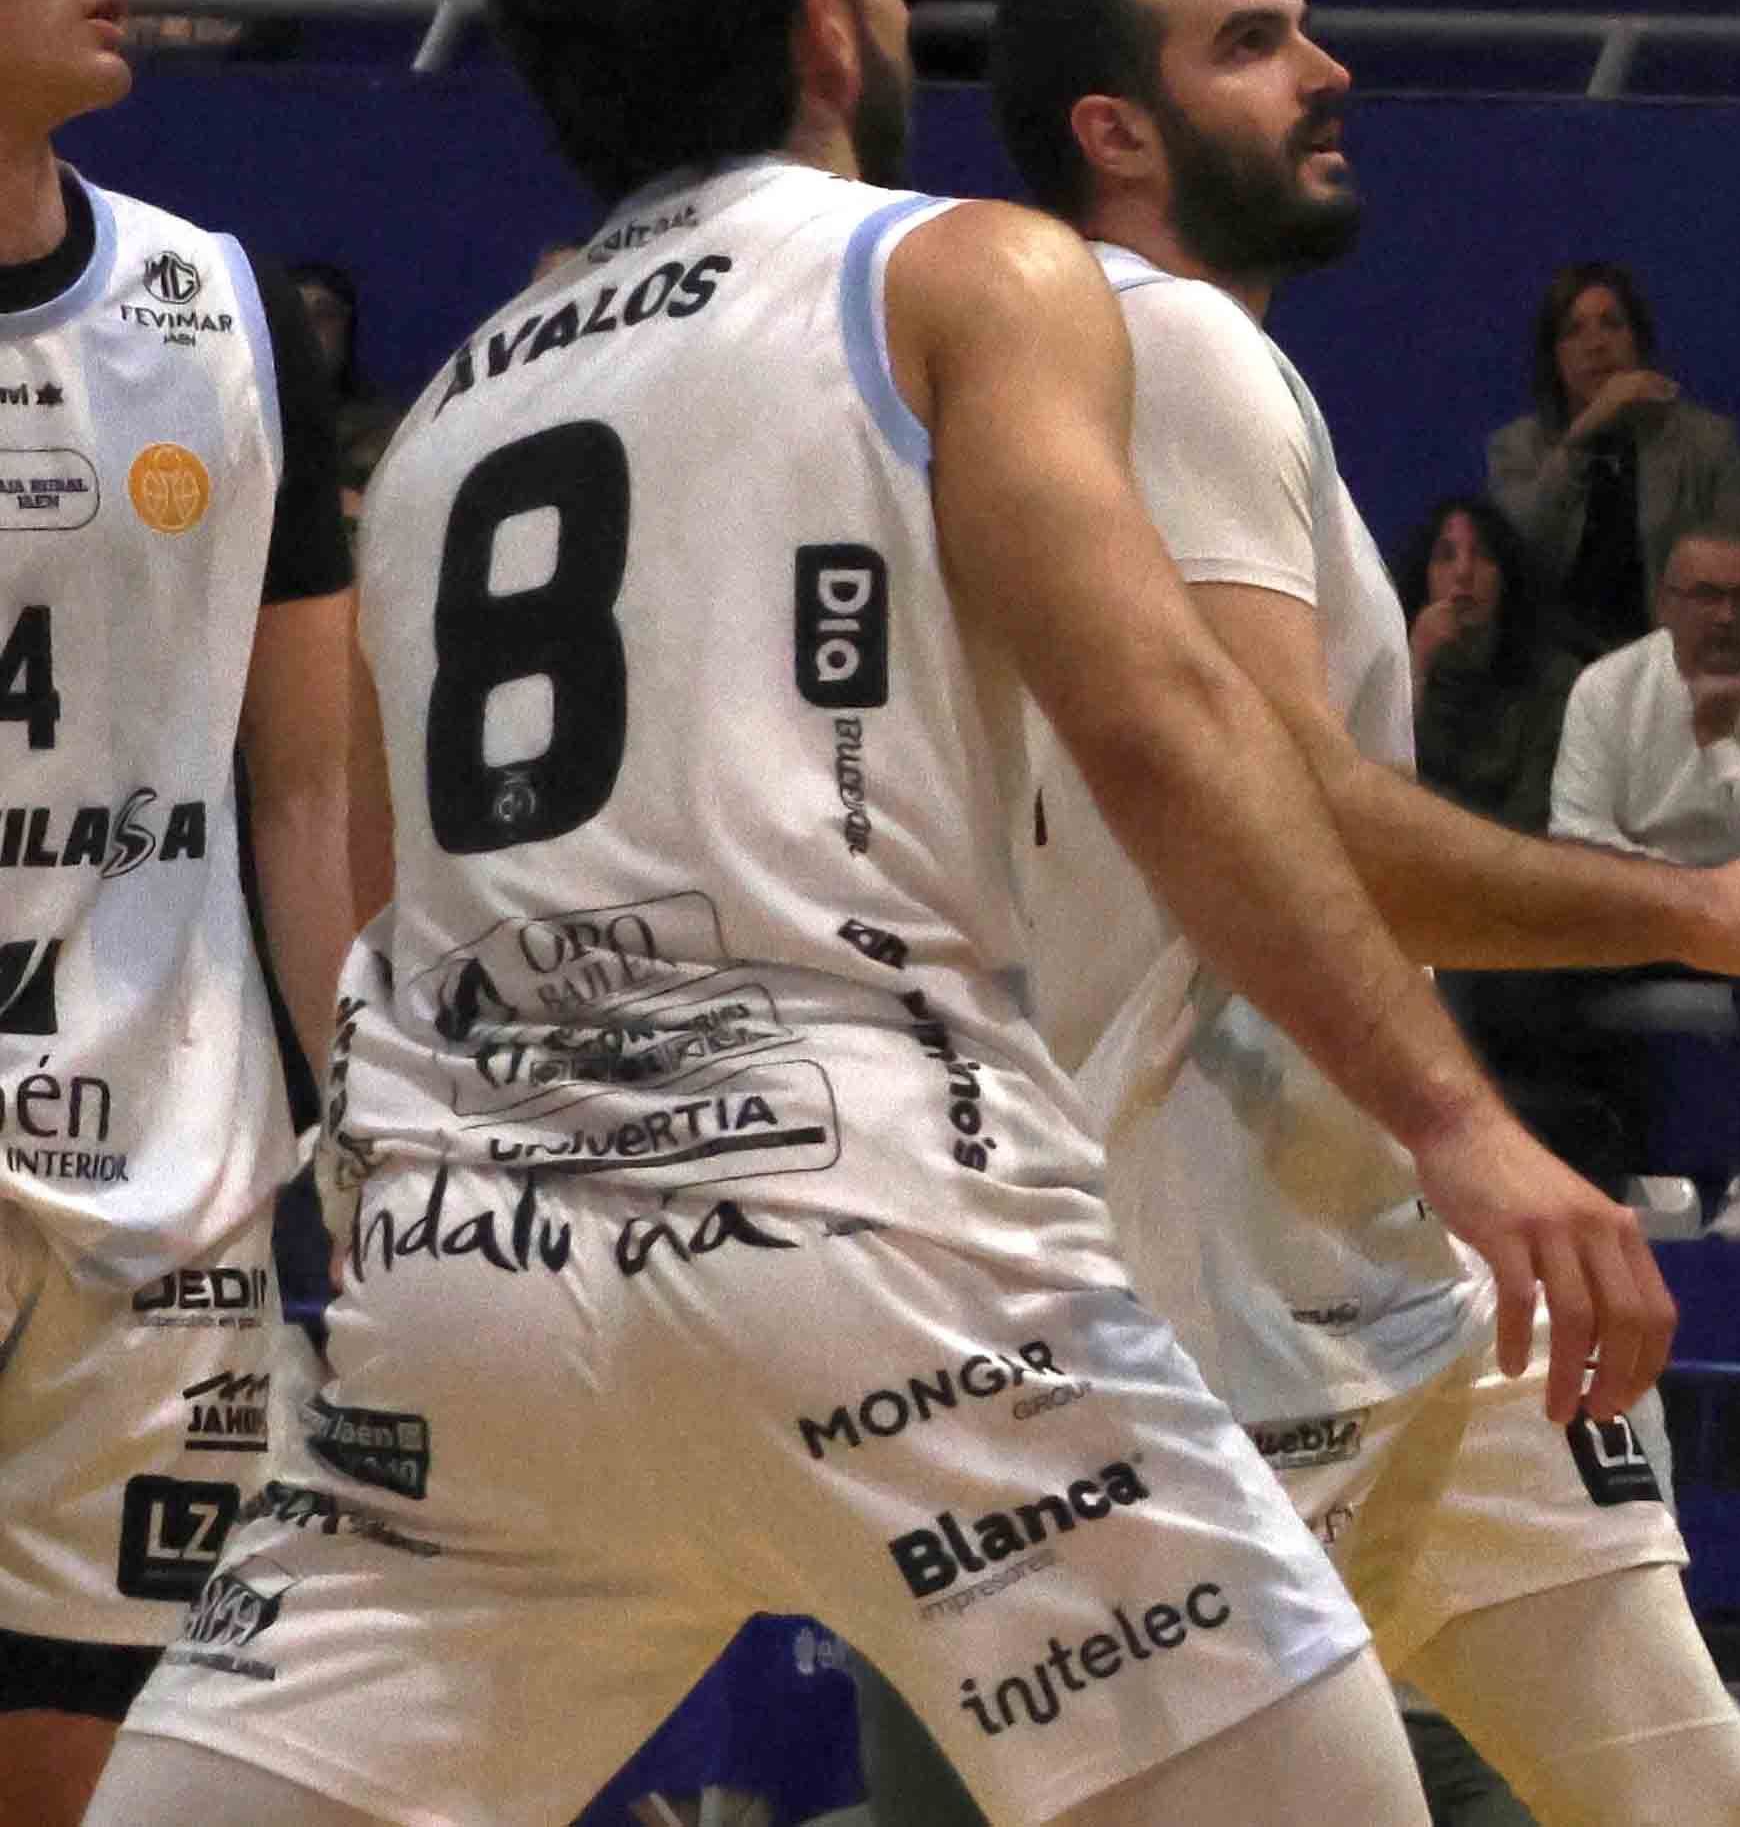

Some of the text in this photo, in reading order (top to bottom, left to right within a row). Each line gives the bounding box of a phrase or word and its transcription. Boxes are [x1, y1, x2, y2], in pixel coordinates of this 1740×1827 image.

[433, 255, 732, 423] AVALOS
[426, 419, 630, 854] 8
[0, 786, 207, 879] ILASA
[0, 1053, 111, 1142] én
[7, 1146, 129, 1182] INTERIOR
[146, 1502, 221, 1561] LZ
[888, 1461, 1150, 1598] Blanca
